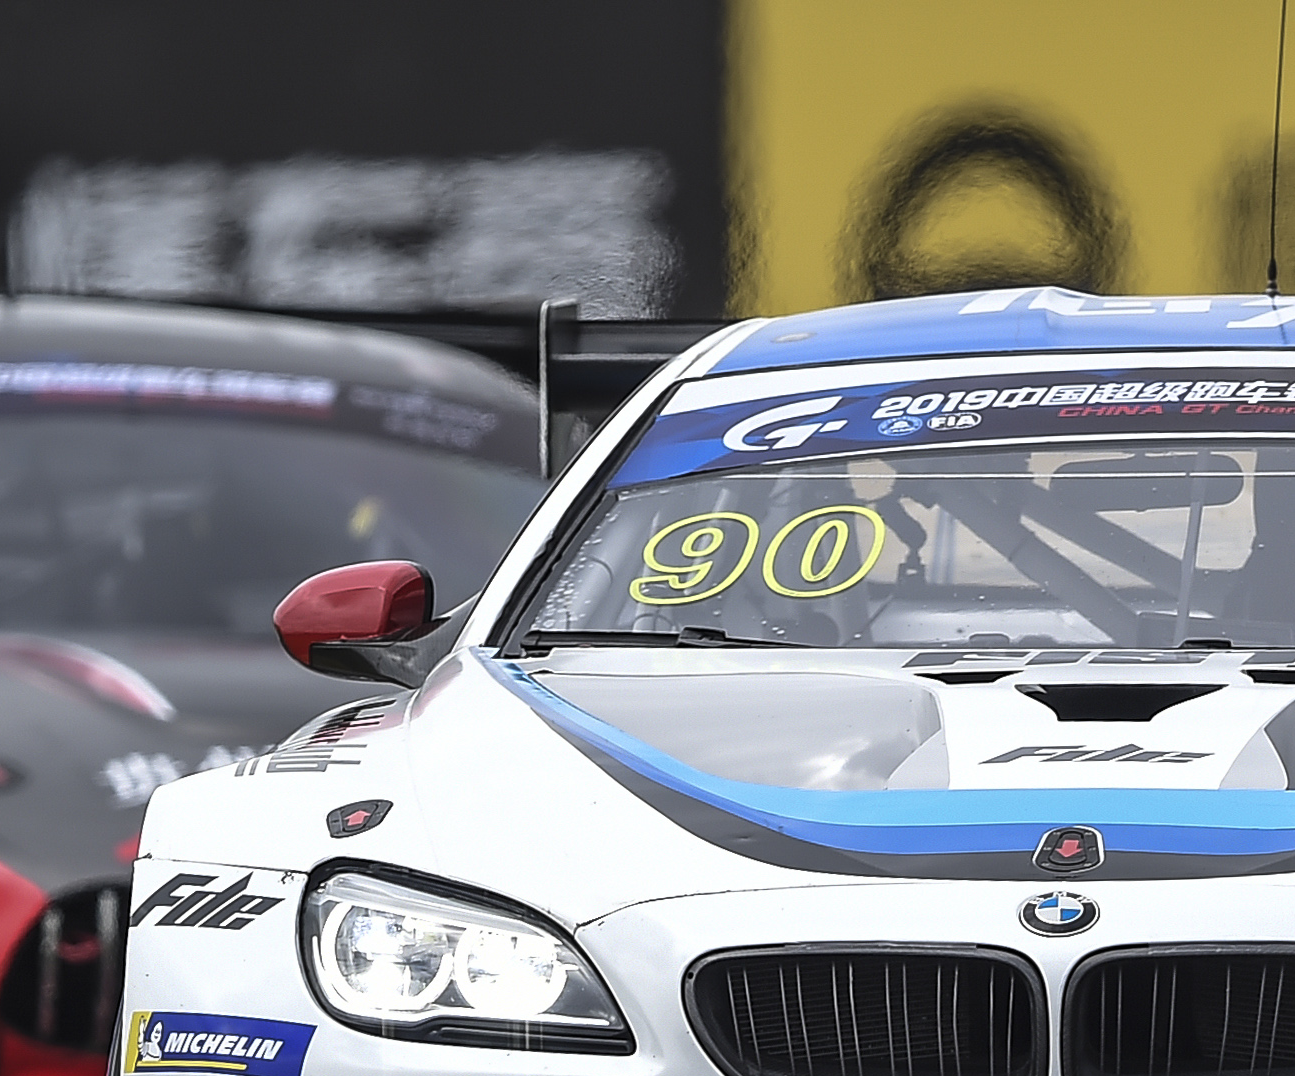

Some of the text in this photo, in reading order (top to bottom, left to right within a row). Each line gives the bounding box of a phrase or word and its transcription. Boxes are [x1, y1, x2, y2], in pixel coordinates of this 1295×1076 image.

[929, 414, 977, 428] FIA
[1057, 405, 1164, 418] CHINA
[1181, 404, 1230, 415] GT
[629, 505, 885, 605] 90
[164, 1032, 284, 1060] MICHELIN
